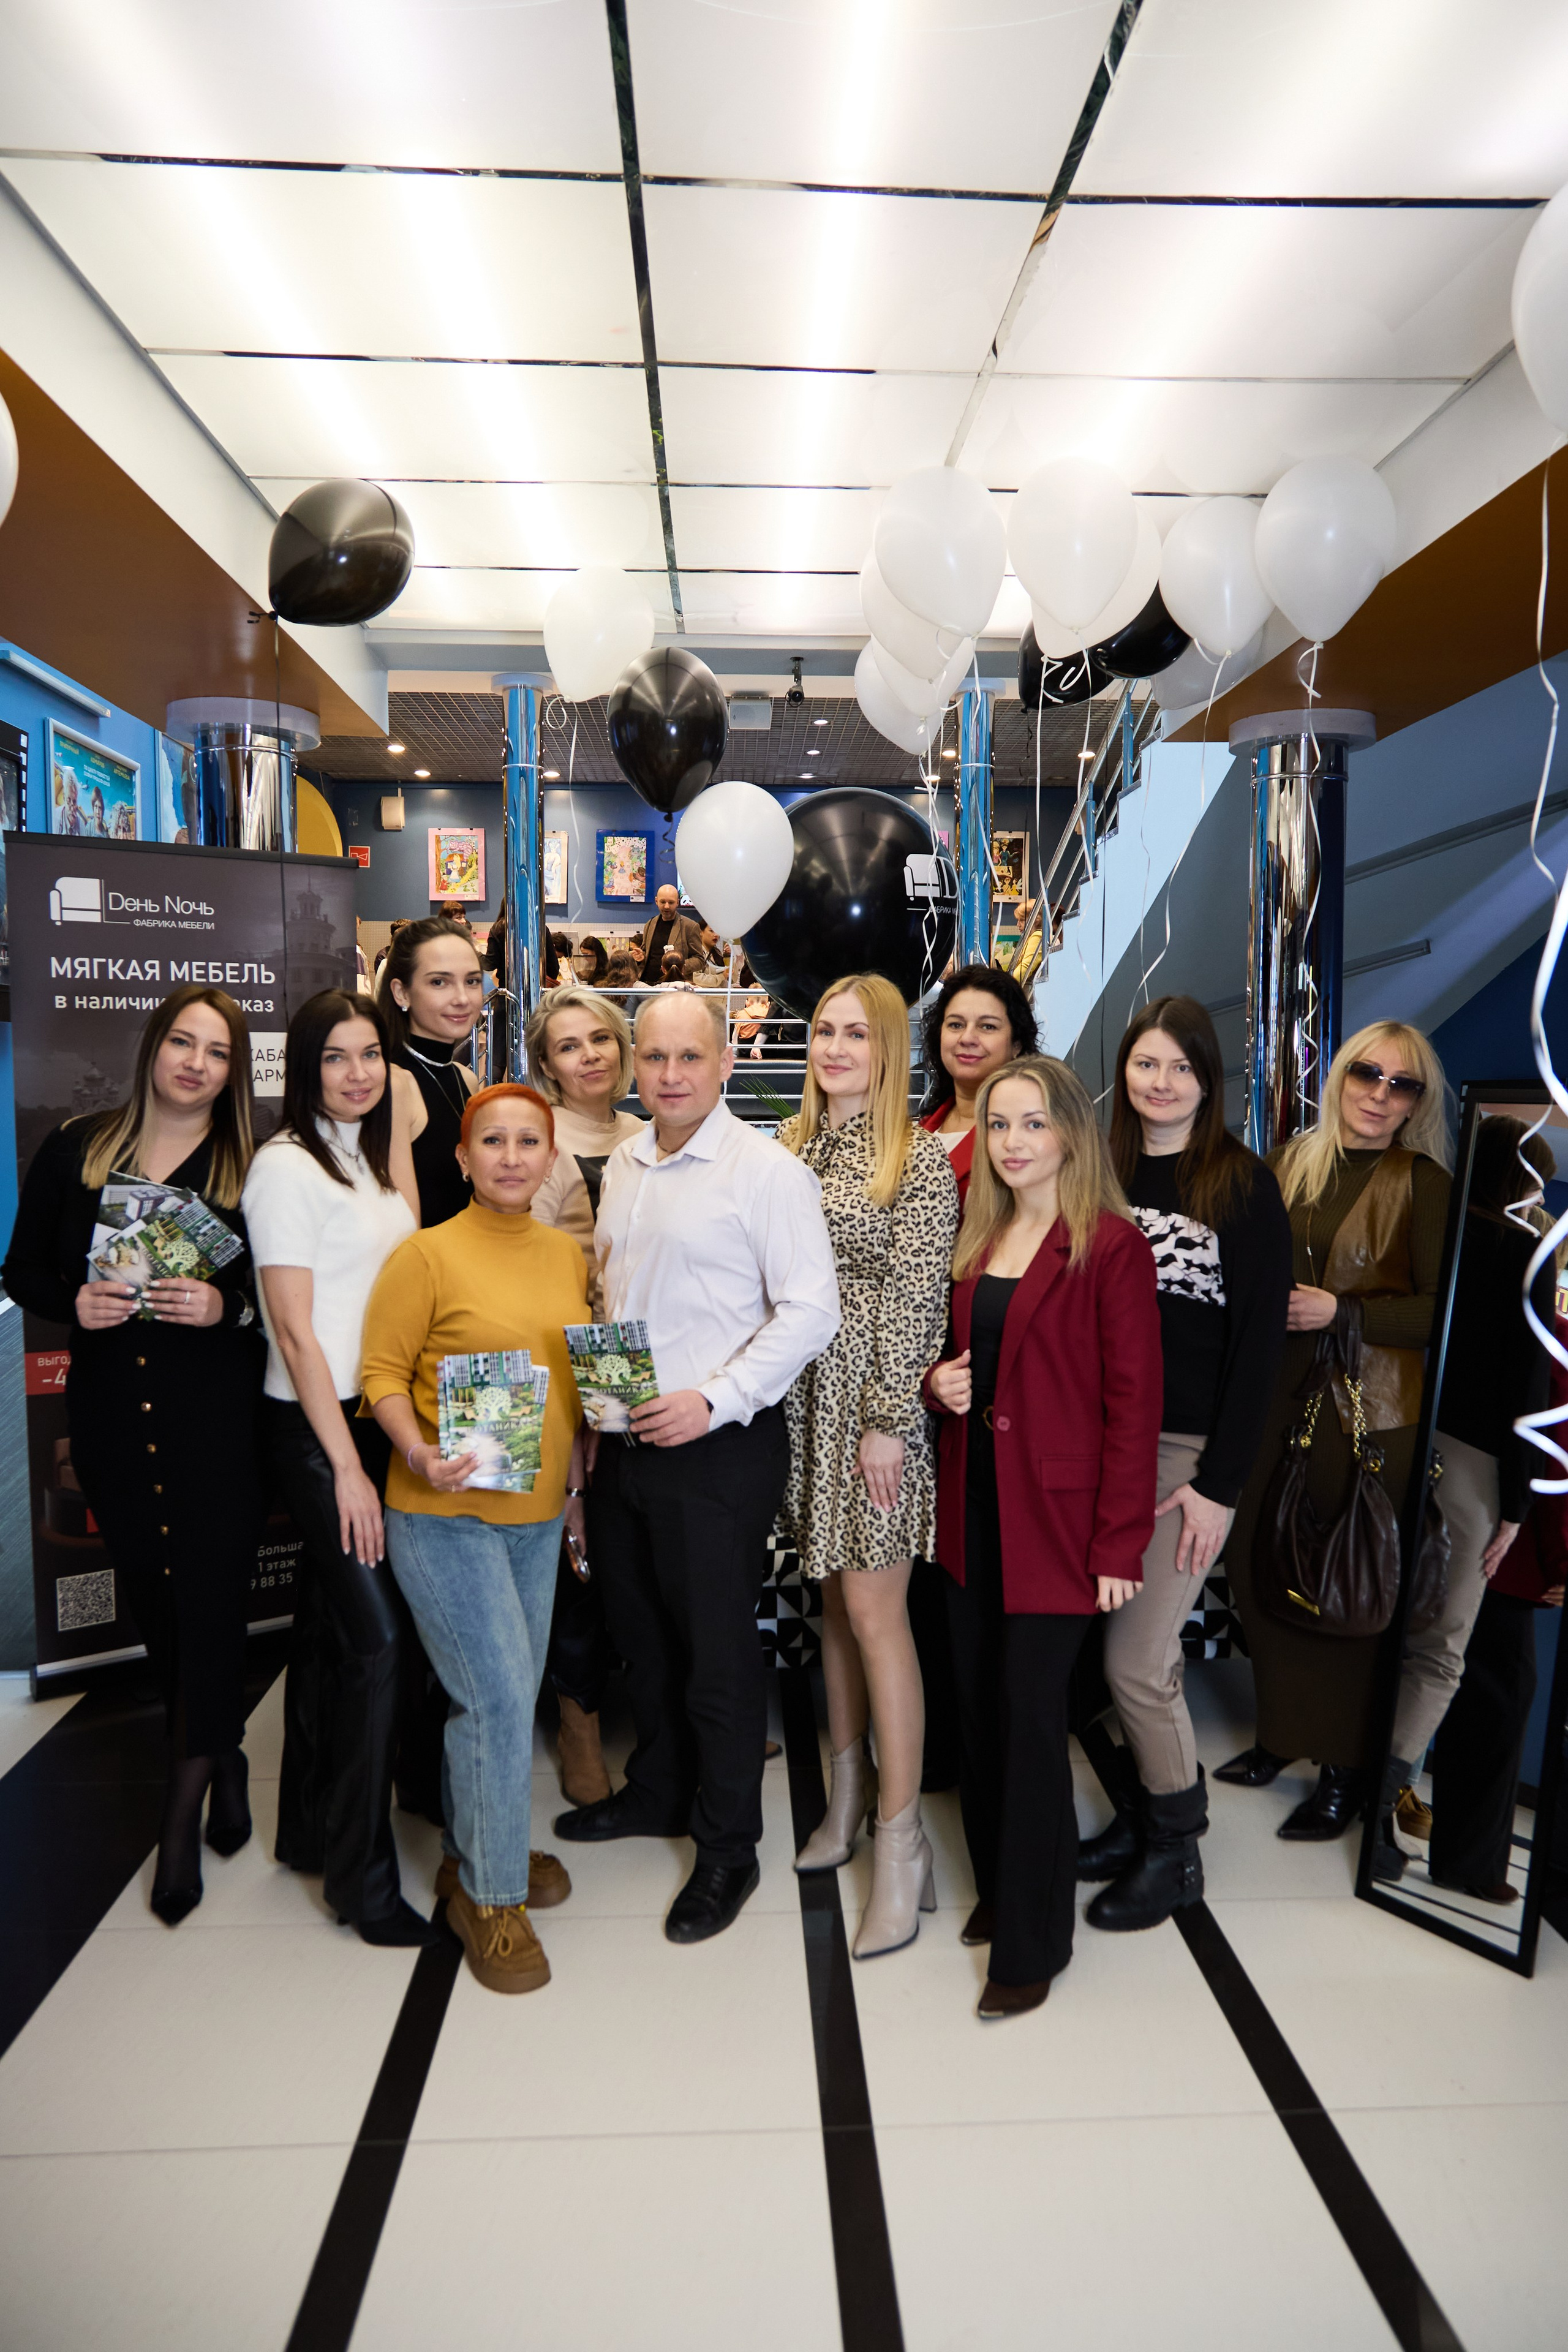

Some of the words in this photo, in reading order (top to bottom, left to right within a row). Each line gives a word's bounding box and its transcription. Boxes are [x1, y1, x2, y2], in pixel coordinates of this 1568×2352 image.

[133, 919, 176, 928] ФАБРИКА
[178, 921, 214, 930] МЕБЕЛИ
[50, 956, 160, 980] МЯГКАЯ
[170, 960, 276, 984] МЕБЕЛЬ
[55, 995, 67, 1008] в
[233, 999, 274, 1012] каз
[251, 1049, 285, 1061] АБА
[253, 1069, 285, 1082] АРМ
[42, 1368, 66, 1385] -4
[257, 1541, 304, 1557] Больша
[258, 1562, 263, 1572] 1
[266, 1558, 296, 1571] этаж
[251, 1578, 257, 1590] 9
[260, 1575, 275, 1588] 88
[279, 1572, 293, 1585] 35
